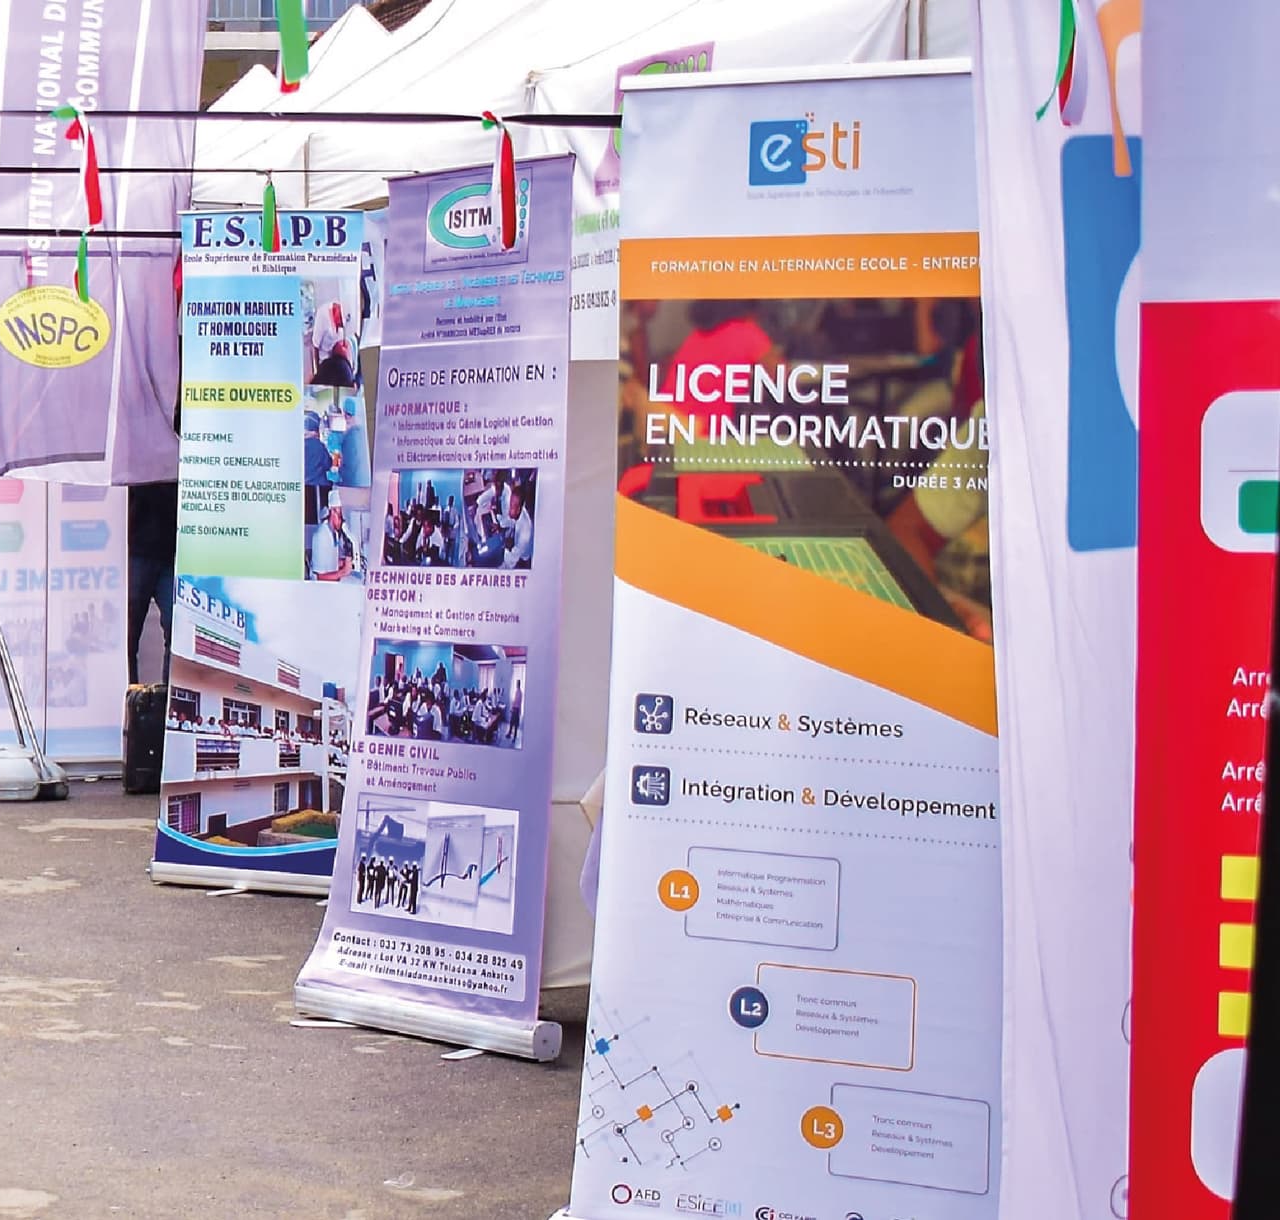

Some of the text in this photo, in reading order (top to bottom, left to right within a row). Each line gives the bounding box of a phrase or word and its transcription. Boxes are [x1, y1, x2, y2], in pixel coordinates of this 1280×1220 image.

[759, 120, 862, 173] esti
[30, 163, 53, 277] INSTITU
[448, 207, 492, 229] ISITM
[193, 215, 347, 248] E.S..P.B
[252, 253, 261, 262] de
[263, 252, 306, 262] Formation
[651, 259, 735, 274] FORMATION
[740, 260, 758, 272] EN
[762, 258, 855, 272] ALTERNANCE
[860, 257, 907, 271] ECOLE
[187, 302, 294, 317] FORMATION HABILITEE
[4, 313, 98, 351] INSPC
[198, 322, 277, 336] ET HOMOLOGUEE
[210, 342, 264, 356] PAR L'ETAT
[431, 371, 445, 385] DE
[451, 366, 520, 384] FORMATION
[526, 365, 544, 380] EN
[648, 363, 849, 405] LICENCE
[185, 388, 292, 403] FILIERE OUVERTES
[384, 401, 460, 416] INFORMATIQUE
[398, 416, 553, 431] Informatique du Génie Logiciel et Gestion
[183, 433, 233, 442] SAGE FEMME
[397, 434, 509, 448] Informatique du Génie Logiciel
[645, 414, 990, 452] EN INFORMATIQUE
[183, 457, 280, 467] INFIRMIER GENERALISTE
[509, 449, 559, 460] Automatisés
[181, 479, 301, 491] TECHNICIEN DE LABORATOIRE
[893, 472, 947, 489] DURÉE
[953, 476, 961, 489] 3
[181, 491, 286, 503] D'ANALYSES BIOLOGIQUES
[181, 503, 225, 512] MEDICALES
[198, 527, 249, 537] SOIGNANTE
[369, 571, 528, 588] TECHNIQUE DES AFFAIRES ET
[367, 589, 416, 602] GESTION
[381, 607, 433, 621] Management
[435, 608, 442, 620] et
[446, 609, 475, 622] Gestion
[380, 623, 475, 637] Marketing et Commerce
[684, 707, 904, 739] Réseaux & Systèmes
[352, 742, 440, 760] LE GENIE CIVIL
[412, 763, 444, 777] Travaux
[447, 767, 477, 781] Publics
[366, 777, 437, 793] et Aménagement
[681, 778, 997, 820] Intégration & Développement
[668, 882, 691, 899] L1
[334, 932, 370, 946] Contact
[380, 939, 396, 950] 033
[400, 942, 411, 952] 73
[435, 947, 445, 957] 95
[455, 951, 472, 961] 034
[476, 954, 488, 964] 28
[510, 959, 523, 970] 49
[380, 953, 393, 962] Lot
[397, 955, 407, 964] VA
[423, 960, 436, 969] KW
[481, 969, 514, 982] Ankatso
[739, 997, 762, 1017] L2
[812, 1119, 836, 1139] L3
[634, 1188, 661, 1201] AFD
